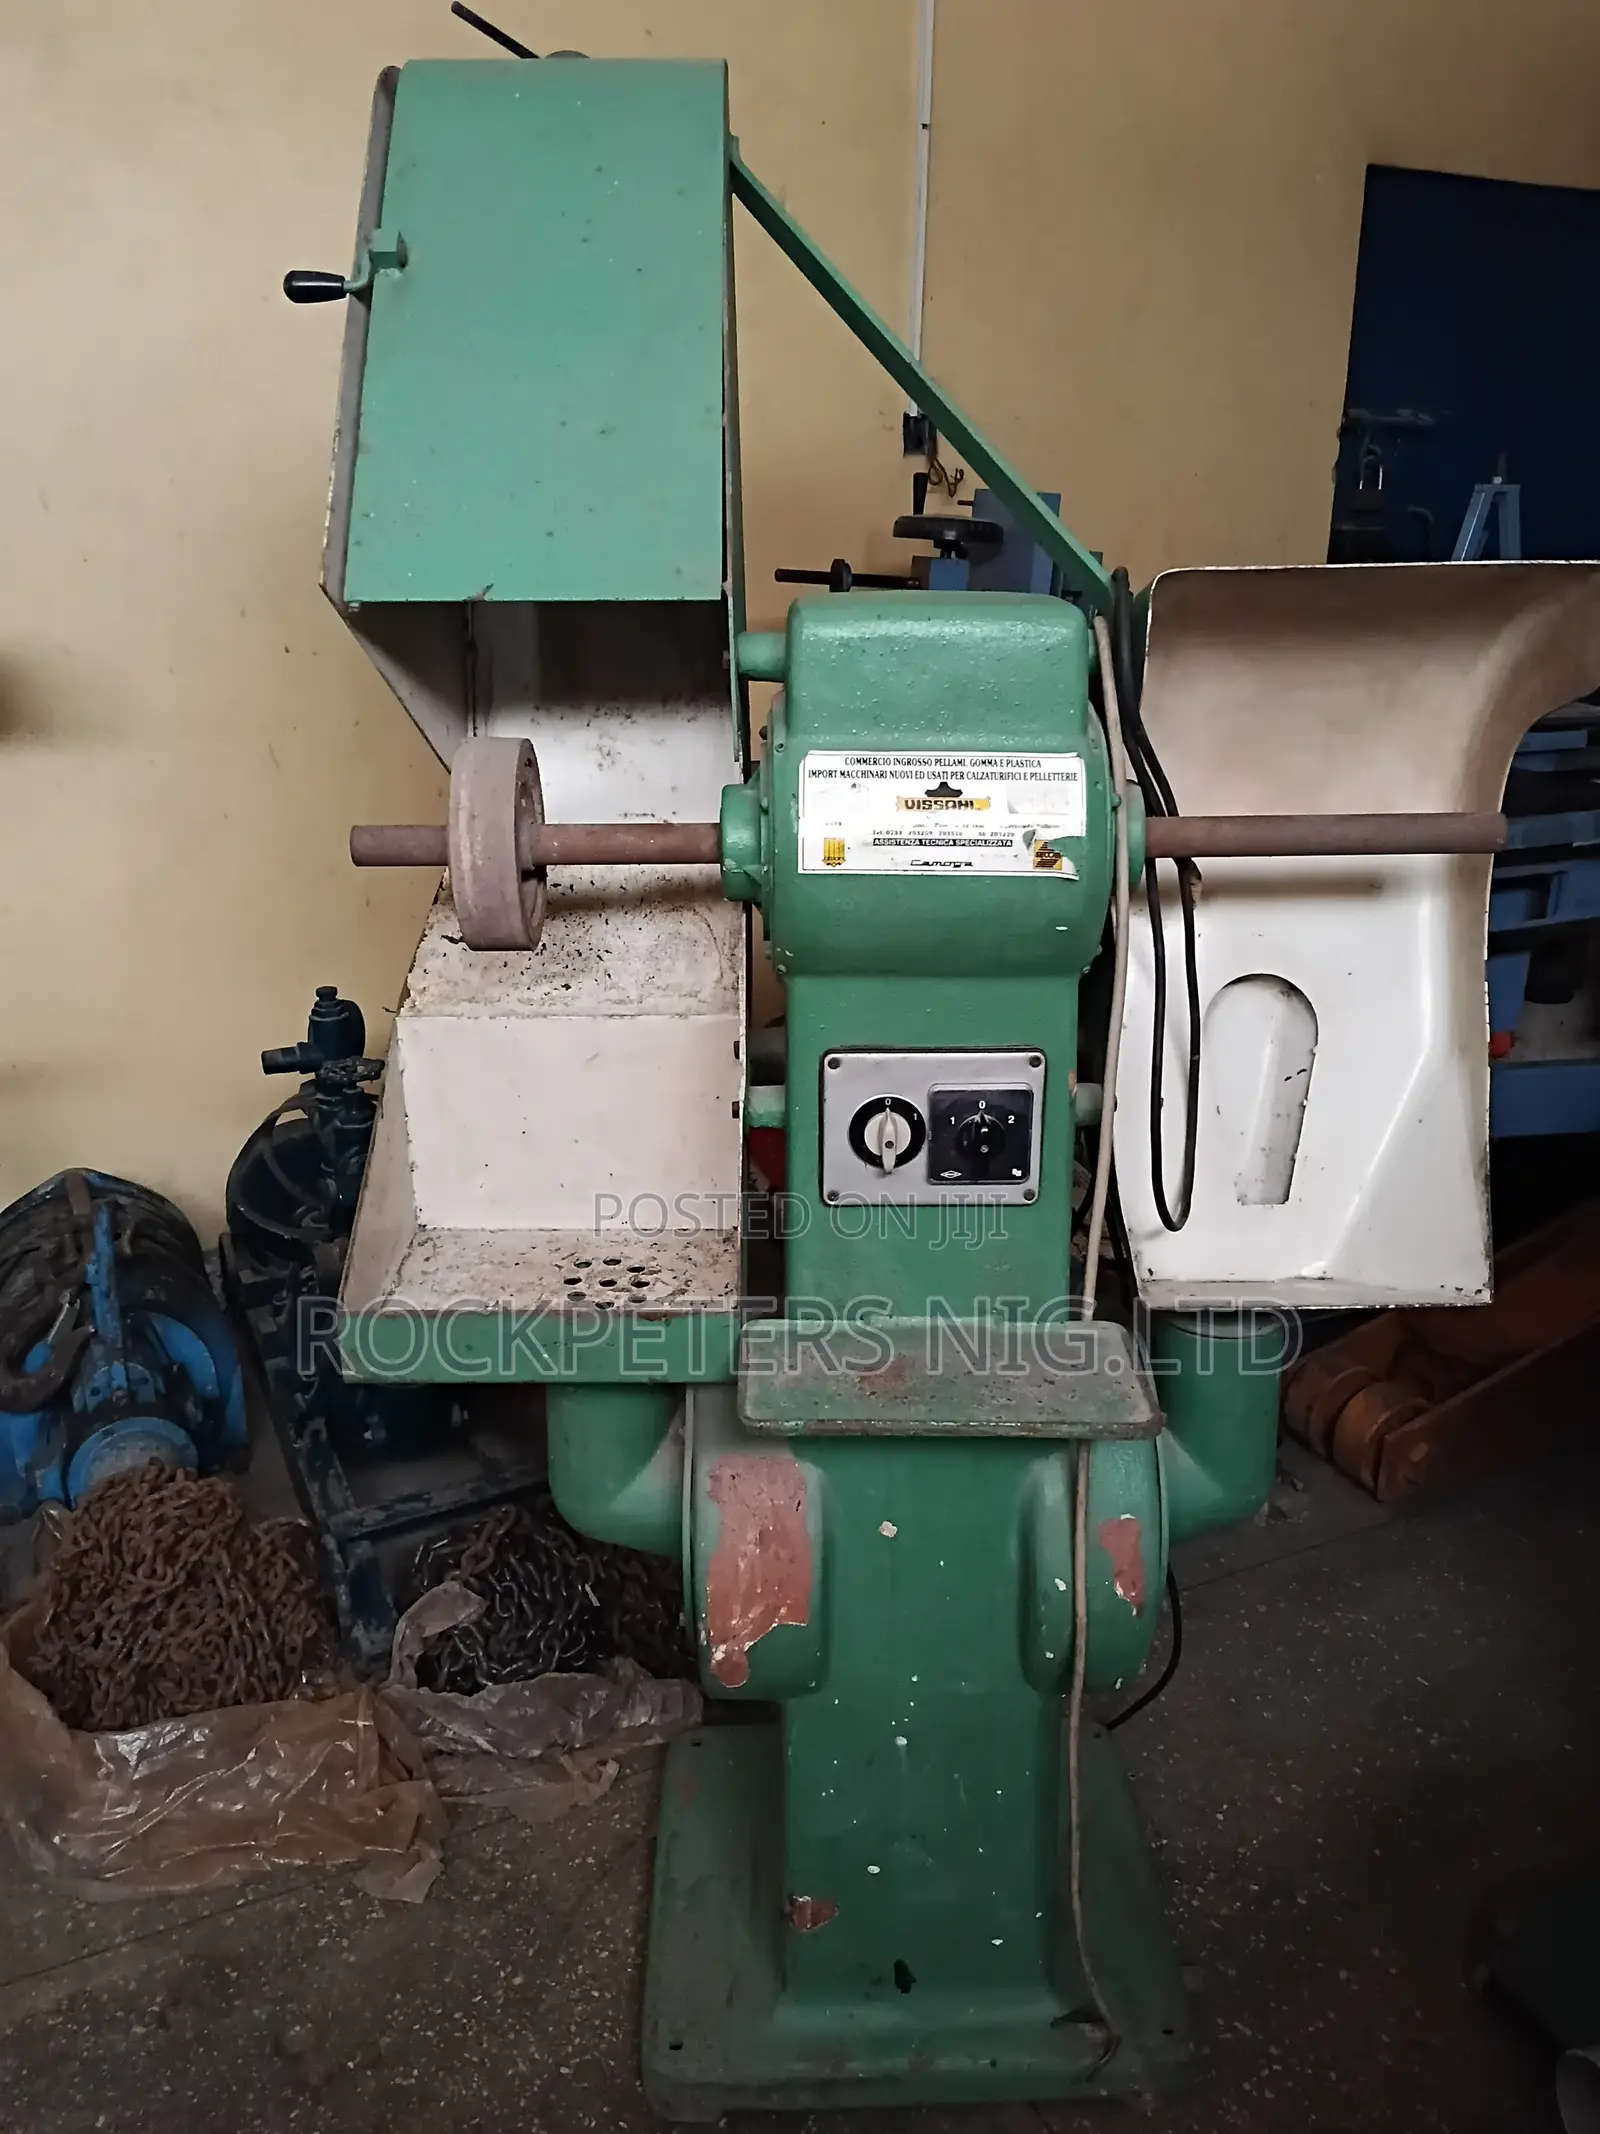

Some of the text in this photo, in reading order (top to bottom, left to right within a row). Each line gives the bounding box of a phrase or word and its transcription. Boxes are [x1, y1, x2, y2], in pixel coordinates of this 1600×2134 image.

[844, 757, 891, 766] COMMERCIO
[893, 758, 932, 766] INGROSSO
[969, 758, 998, 767] GOMMA
[1000, 759, 1004, 767] E
[1006, 759, 1042, 768] PLASTICA
[808, 769, 1079, 781] IMPORT MACCHINARI NUOVI ED USATI PER CALZATURIFICI E PELLETTERIE
[873, 838, 1012, 847] ASSISTENZA TECNICA SPECIALIZZATA
[979, 1100, 986, 1109] 0
[950, 1115, 1015, 1125] 1 2
